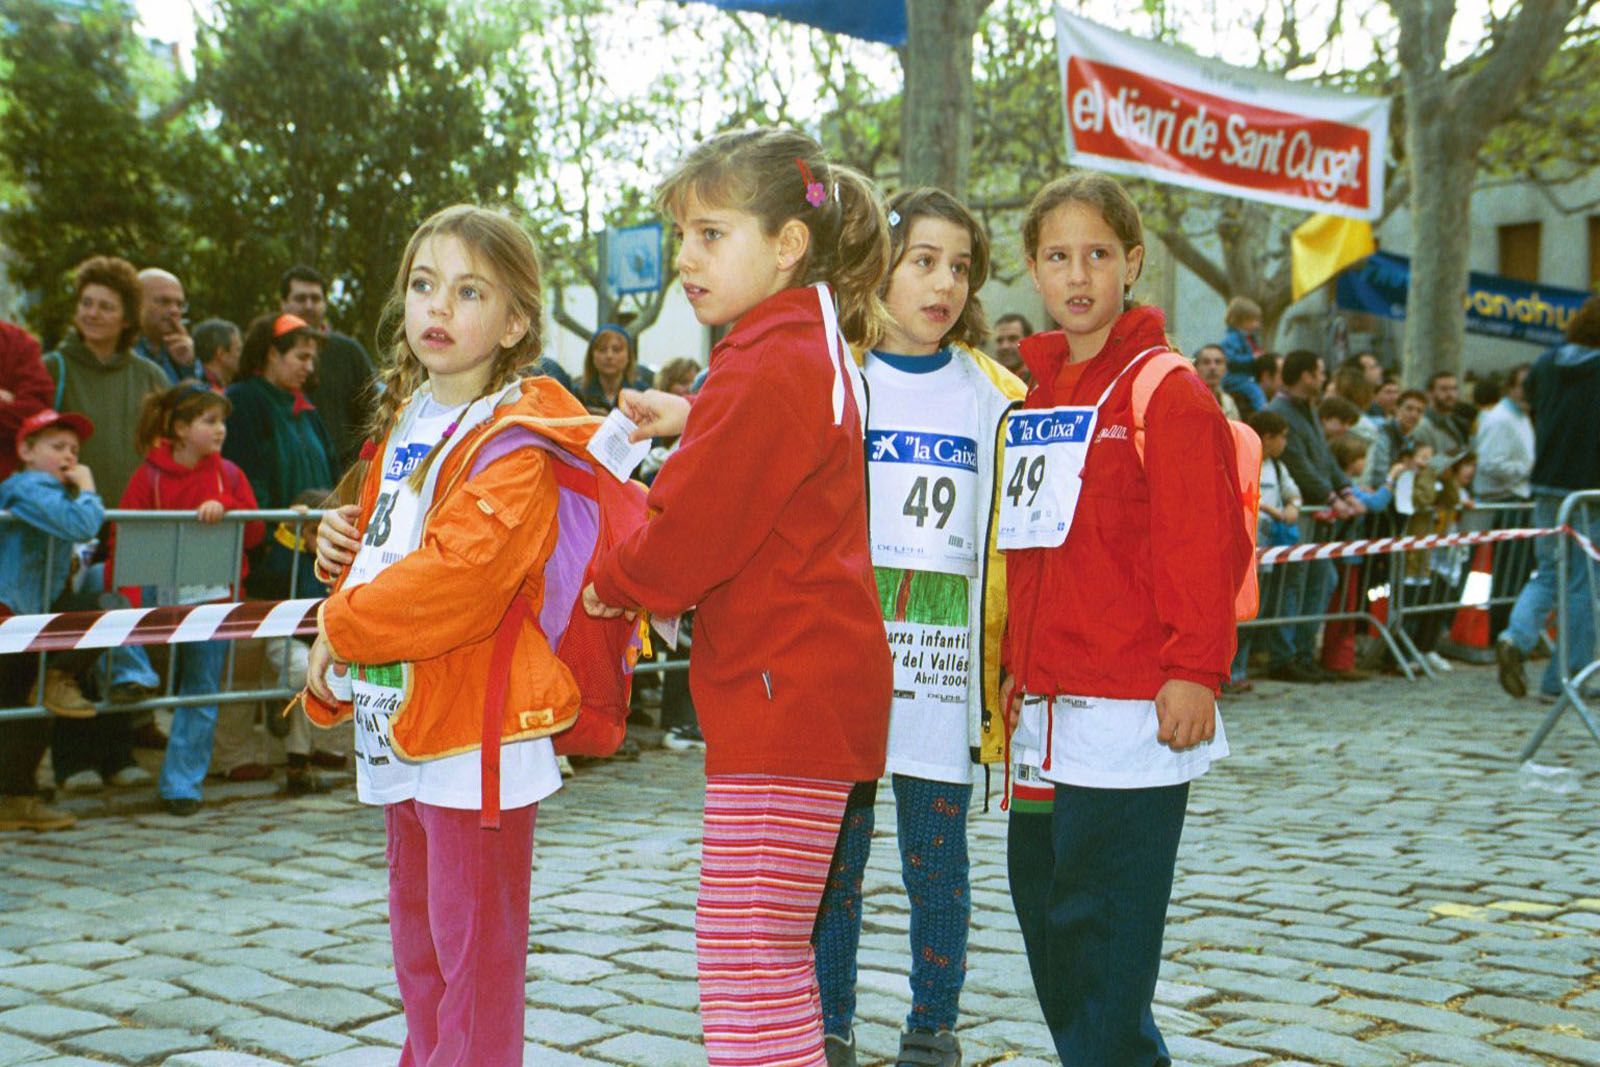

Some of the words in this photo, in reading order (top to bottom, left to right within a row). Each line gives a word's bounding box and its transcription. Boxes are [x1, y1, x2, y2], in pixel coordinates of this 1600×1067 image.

[1073, 79, 1104, 132] el
[1107, 86, 1179, 151] diari
[1178, 104, 1218, 160] de
[1220, 114, 1287, 176] Sant
[1286, 131, 1363, 198] Cugat
[1006, 454, 1046, 507] 49
[903, 475, 957, 529] 49
[888, 632, 914, 646] arxa
[920, 630, 970, 651] infantil
[902, 653, 923, 668] del
[931, 655, 970, 673] Vallés
[914, 672, 939, 686] Abril
[942, 675, 968, 688] 2004
[373, 692, 401, 711] infa
